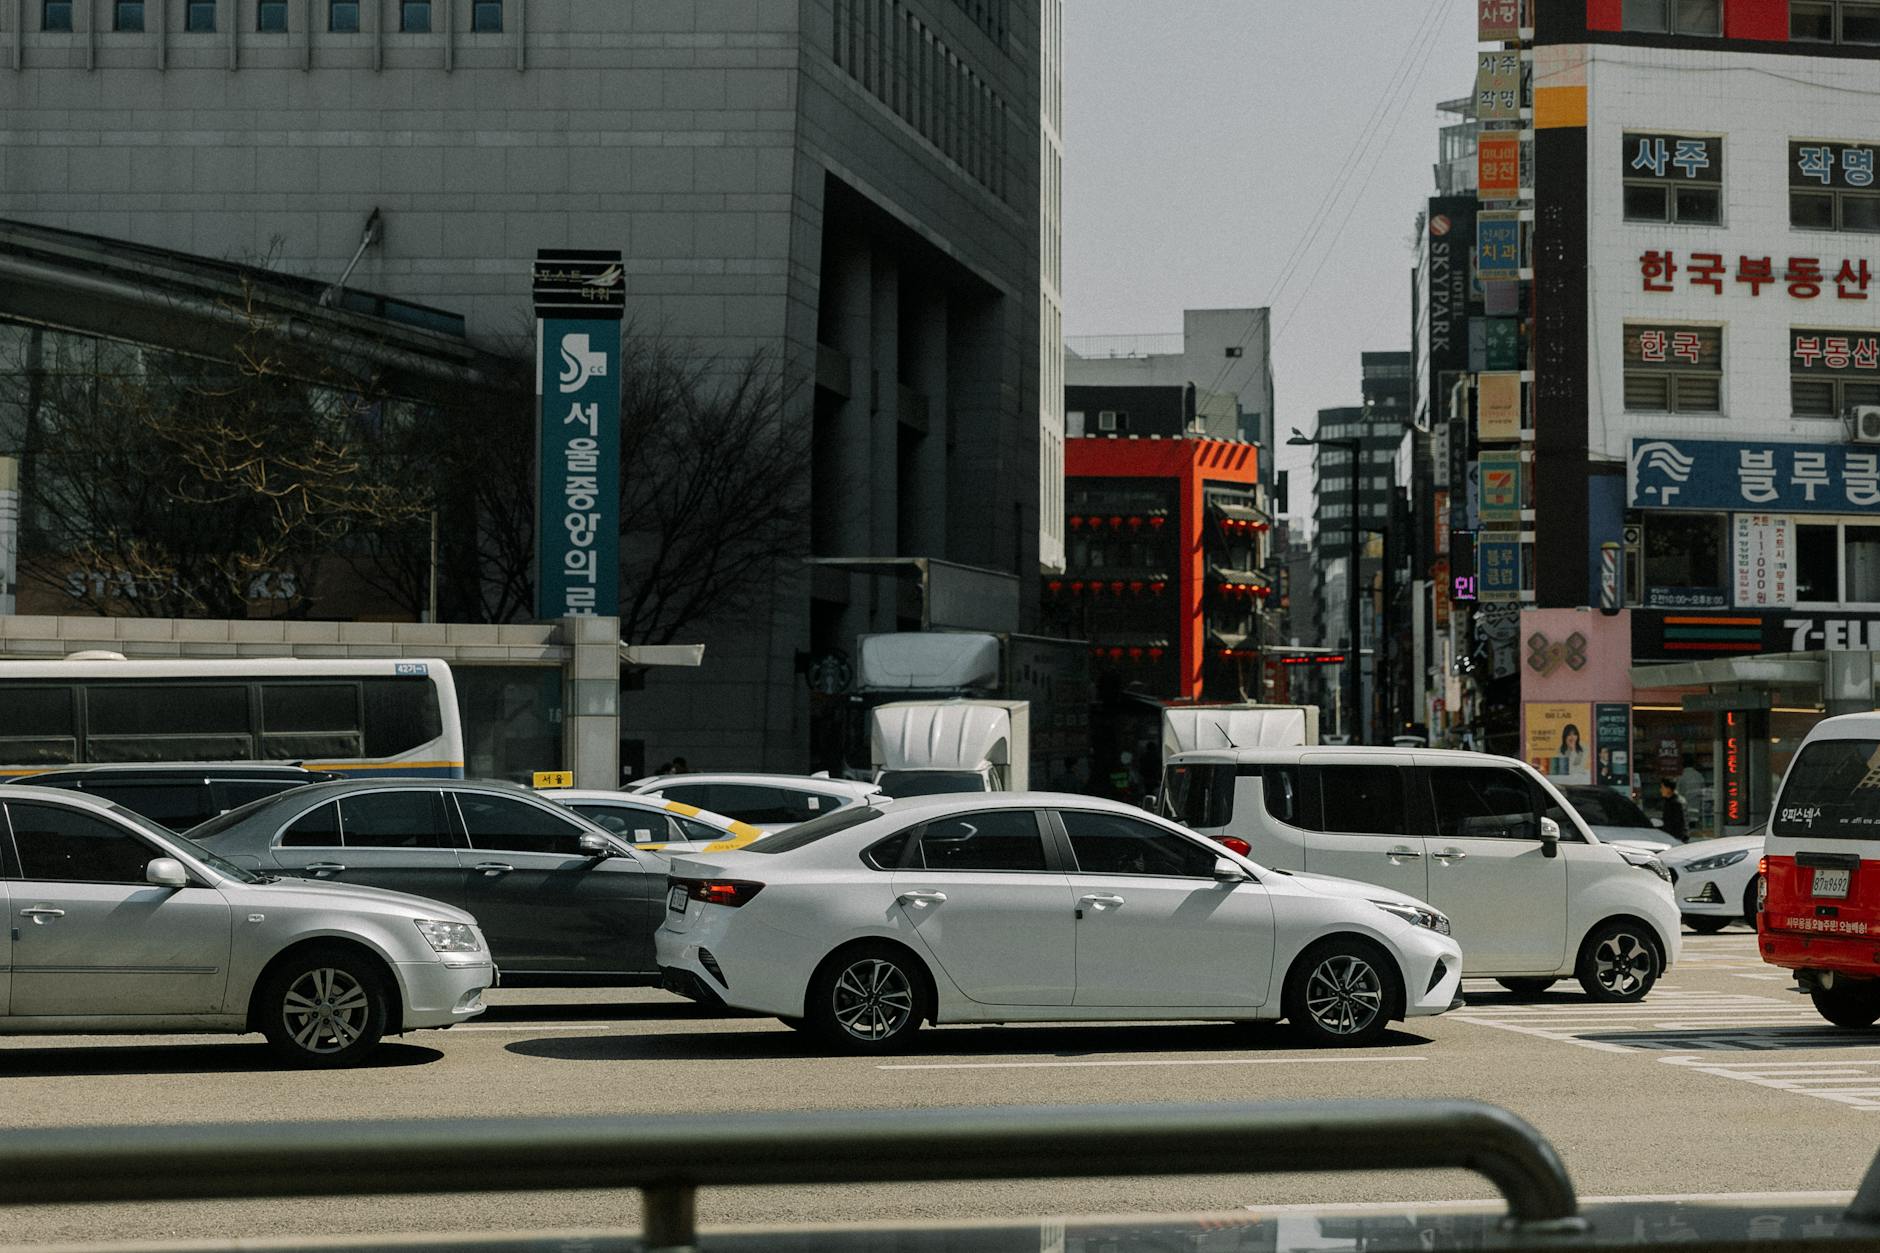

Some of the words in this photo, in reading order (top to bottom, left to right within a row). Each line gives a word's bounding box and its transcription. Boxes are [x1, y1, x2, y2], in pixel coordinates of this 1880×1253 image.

[1481, 56, 1517, 75] 사주
[1480, 90, 1515, 110] 작명
[1632, 138, 1710, 178] 사주
[1798, 146, 1875, 187] 작명
[1482, 243, 1517, 260] 치과
[1639, 251, 1872, 300] 한국부동산
[1431, 243, 1450, 351] SKYPARK
[1452, 270, 1465, 320] HOTEL
[1640, 331, 1701, 364] 한국
[1794, 337, 1879, 369] 부동산
[1738, 449, 1880, 506] 블루클
[543, 774, 564, 785] 서울
